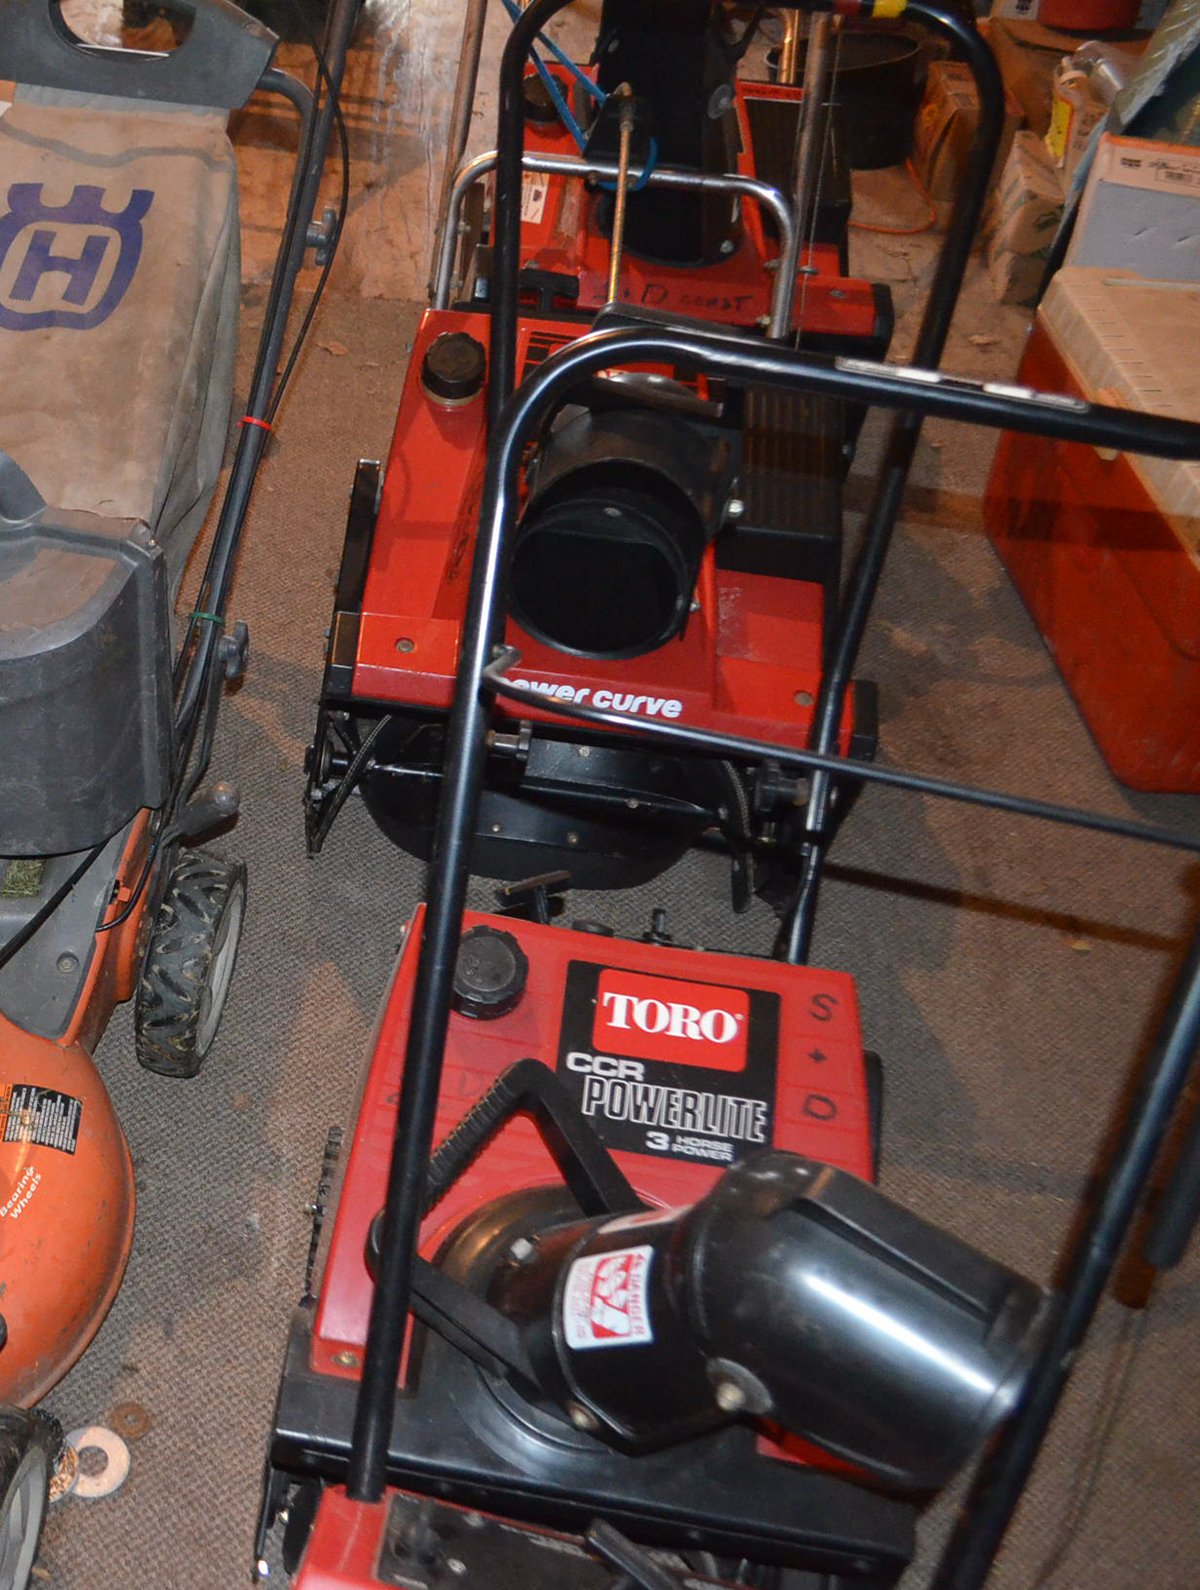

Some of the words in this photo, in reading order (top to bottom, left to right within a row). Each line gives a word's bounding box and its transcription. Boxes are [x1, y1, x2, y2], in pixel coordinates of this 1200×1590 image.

[8, 229, 111, 306] H
[592, 689, 683, 718] curve
[603, 992, 739, 1043] TORO
[807, 993, 838, 1022] S
[566, 1051, 646, 1082] CCR
[581, 1075, 769, 1143] POWERLITE
[803, 1093, 837, 1121] D
[645, 1131, 671, 1151] 3
[675, 1134, 734, 1152] HORSE
[672, 1143, 733, 1162] POWER
[0, 1165, 35, 1217] Bearing
[9, 1173, 42, 1219] Wheels
